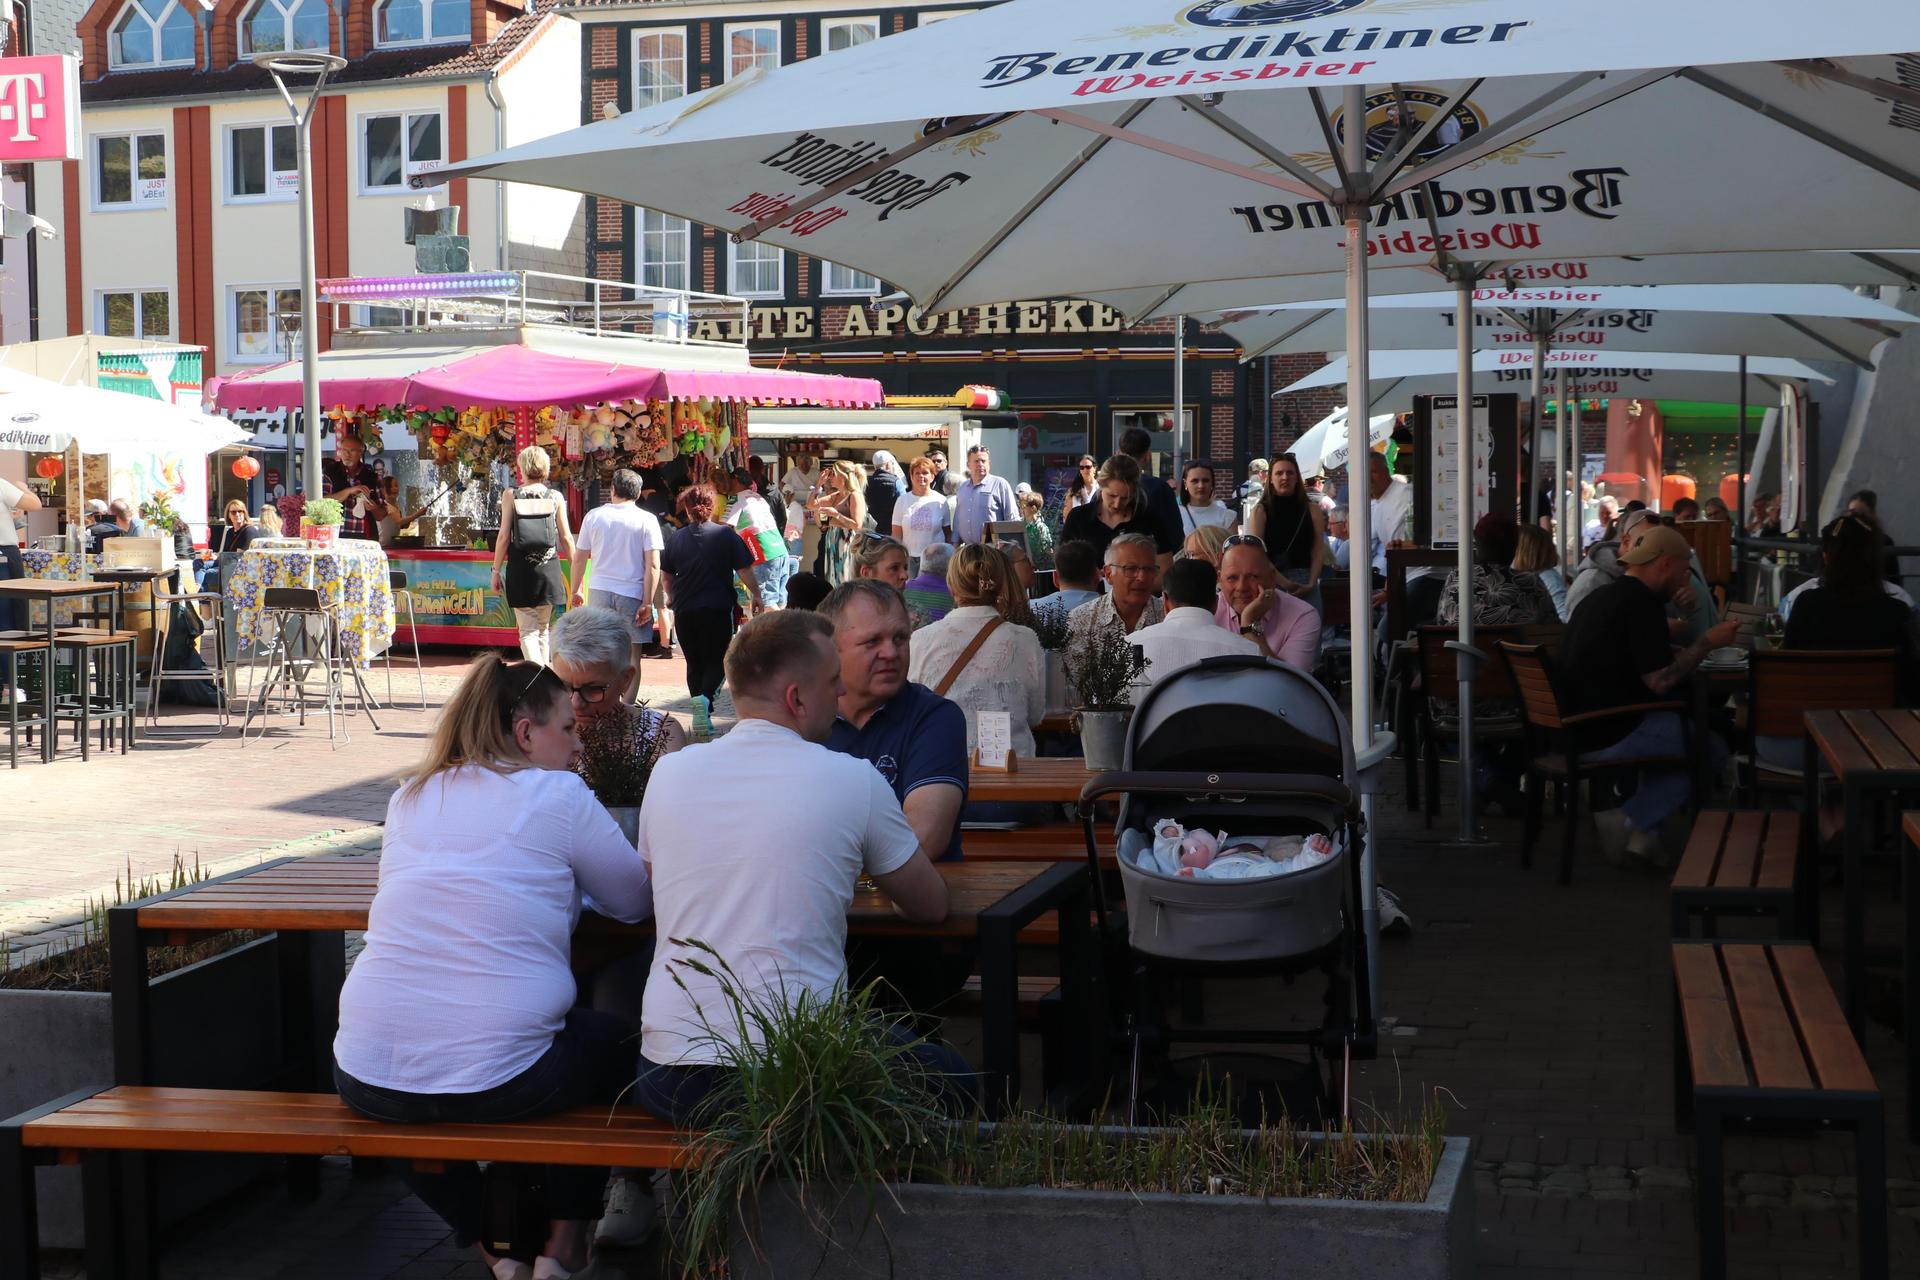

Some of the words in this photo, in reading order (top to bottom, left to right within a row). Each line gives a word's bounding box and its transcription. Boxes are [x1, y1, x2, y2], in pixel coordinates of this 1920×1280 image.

[980, 21, 1530, 88] Benediktiner
[1070, 59, 1377, 98] Weissbier
[146, 180, 166, 189] JUST
[843, 299, 1120, 337] APOTHEKE
[1499, 352, 1598, 364] Wessbier
